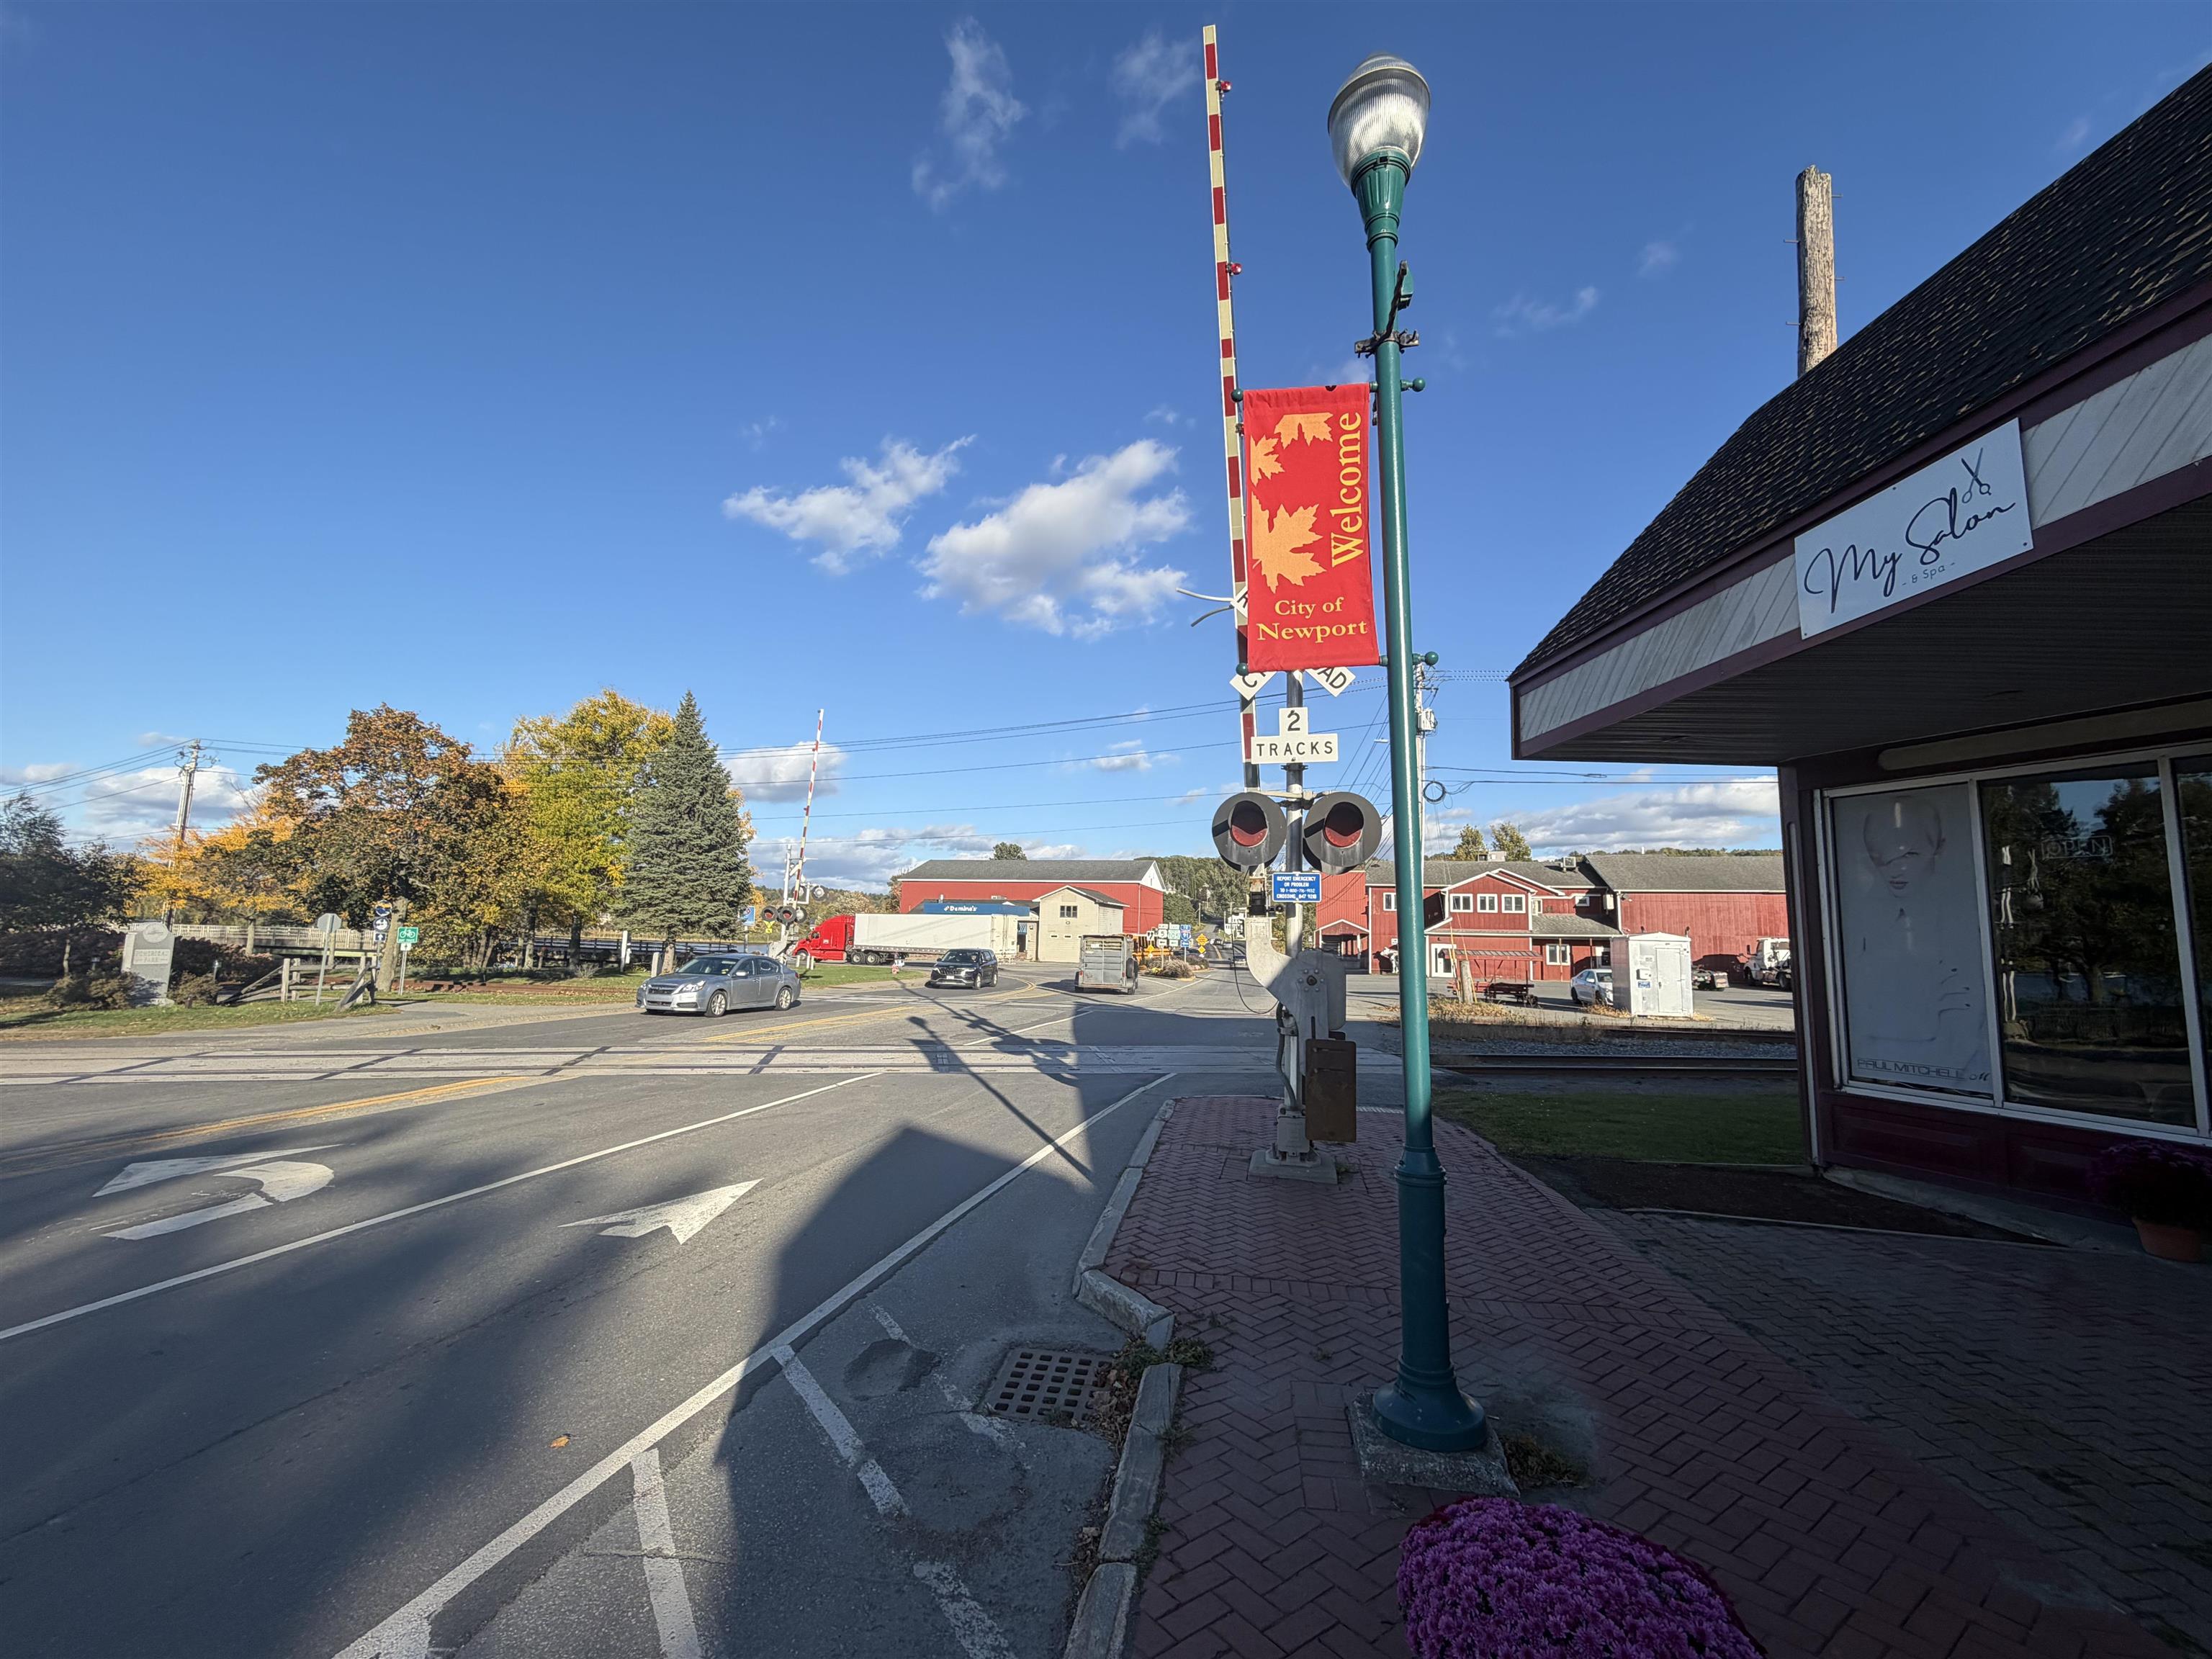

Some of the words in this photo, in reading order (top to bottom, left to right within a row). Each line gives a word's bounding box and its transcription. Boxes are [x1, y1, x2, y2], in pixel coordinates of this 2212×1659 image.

[1331, 411, 1364, 568] Welcome
[1804, 544, 1903, 613] My
[1905, 487, 2016, 566] Salon
[1923, 565, 1946, 580] Spa
[1274, 600, 1316, 619] City
[1323, 597, 1344, 613] of
[1257, 620, 1367, 643] Newport
[1287, 711, 1301, 732] 2
[1256, 741, 1334, 757] TRACKS
[1856, 1058, 1892, 1071] PAUL
[1893, 1062, 1966, 1080] MITCHELL
